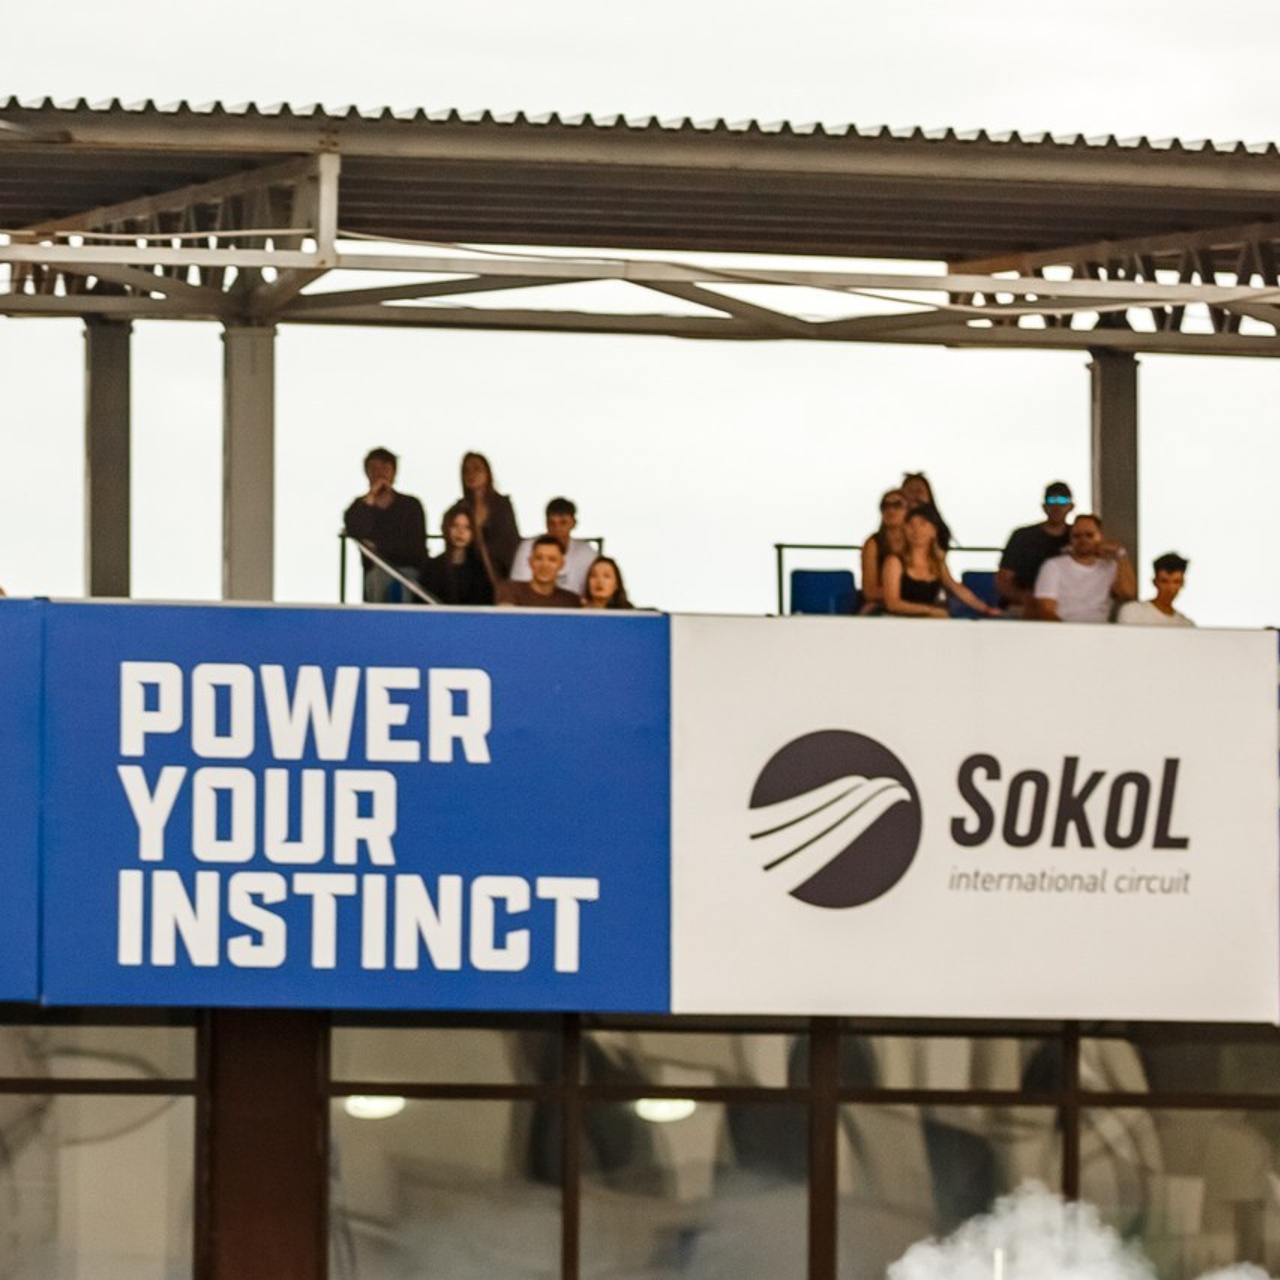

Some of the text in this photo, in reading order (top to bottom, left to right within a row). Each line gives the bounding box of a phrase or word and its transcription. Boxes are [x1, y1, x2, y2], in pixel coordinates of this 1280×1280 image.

[119, 661, 492, 764] POWER
[117, 765, 397, 866] YOUR
[118, 869, 600, 973] INSTINCT
[948, 866, 1191, 894] international circuit
